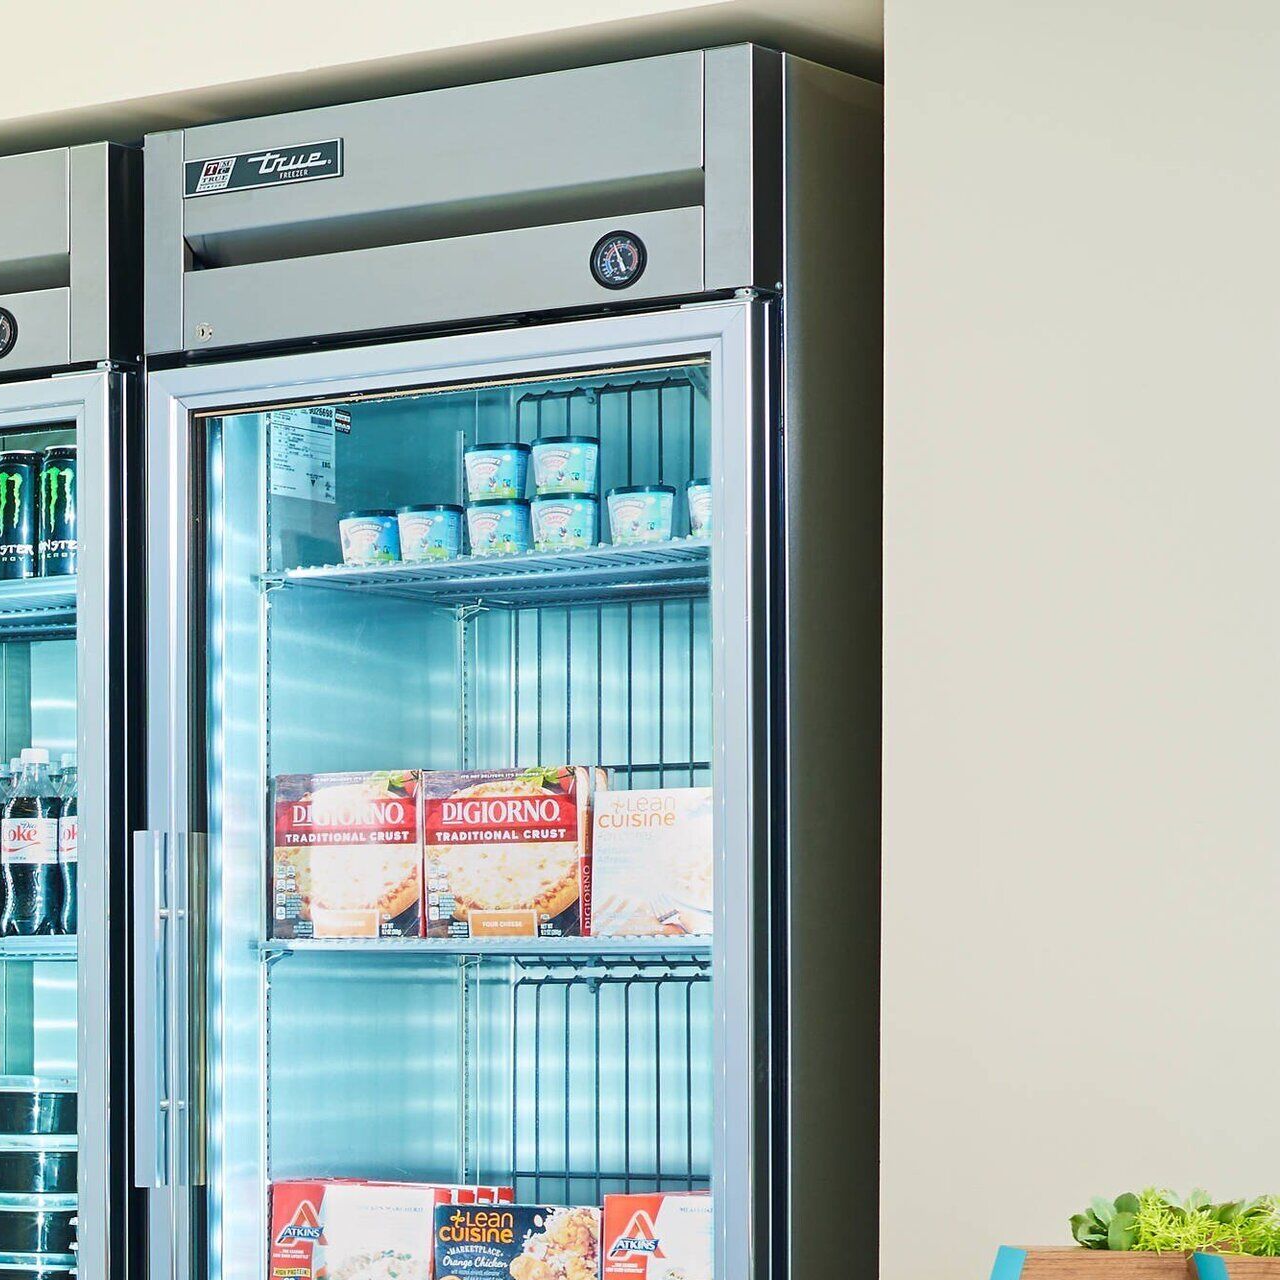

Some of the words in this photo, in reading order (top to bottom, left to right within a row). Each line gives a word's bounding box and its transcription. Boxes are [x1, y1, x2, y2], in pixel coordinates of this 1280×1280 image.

[279, 169, 309, 179] FREEZER
[286, 832, 366, 843] TRADITIONAL
[370, 831, 409, 841] CRUST
[436, 830, 518, 842] TRADITIONAL
[524, 829, 566, 839] CRUST
[284, 1228, 320, 1237] ATKINS
[617, 1240, 656, 1250] ATKINS
[443, 1256, 472, 1268] Orange
[474, 1257, 508, 1268] Chicken
